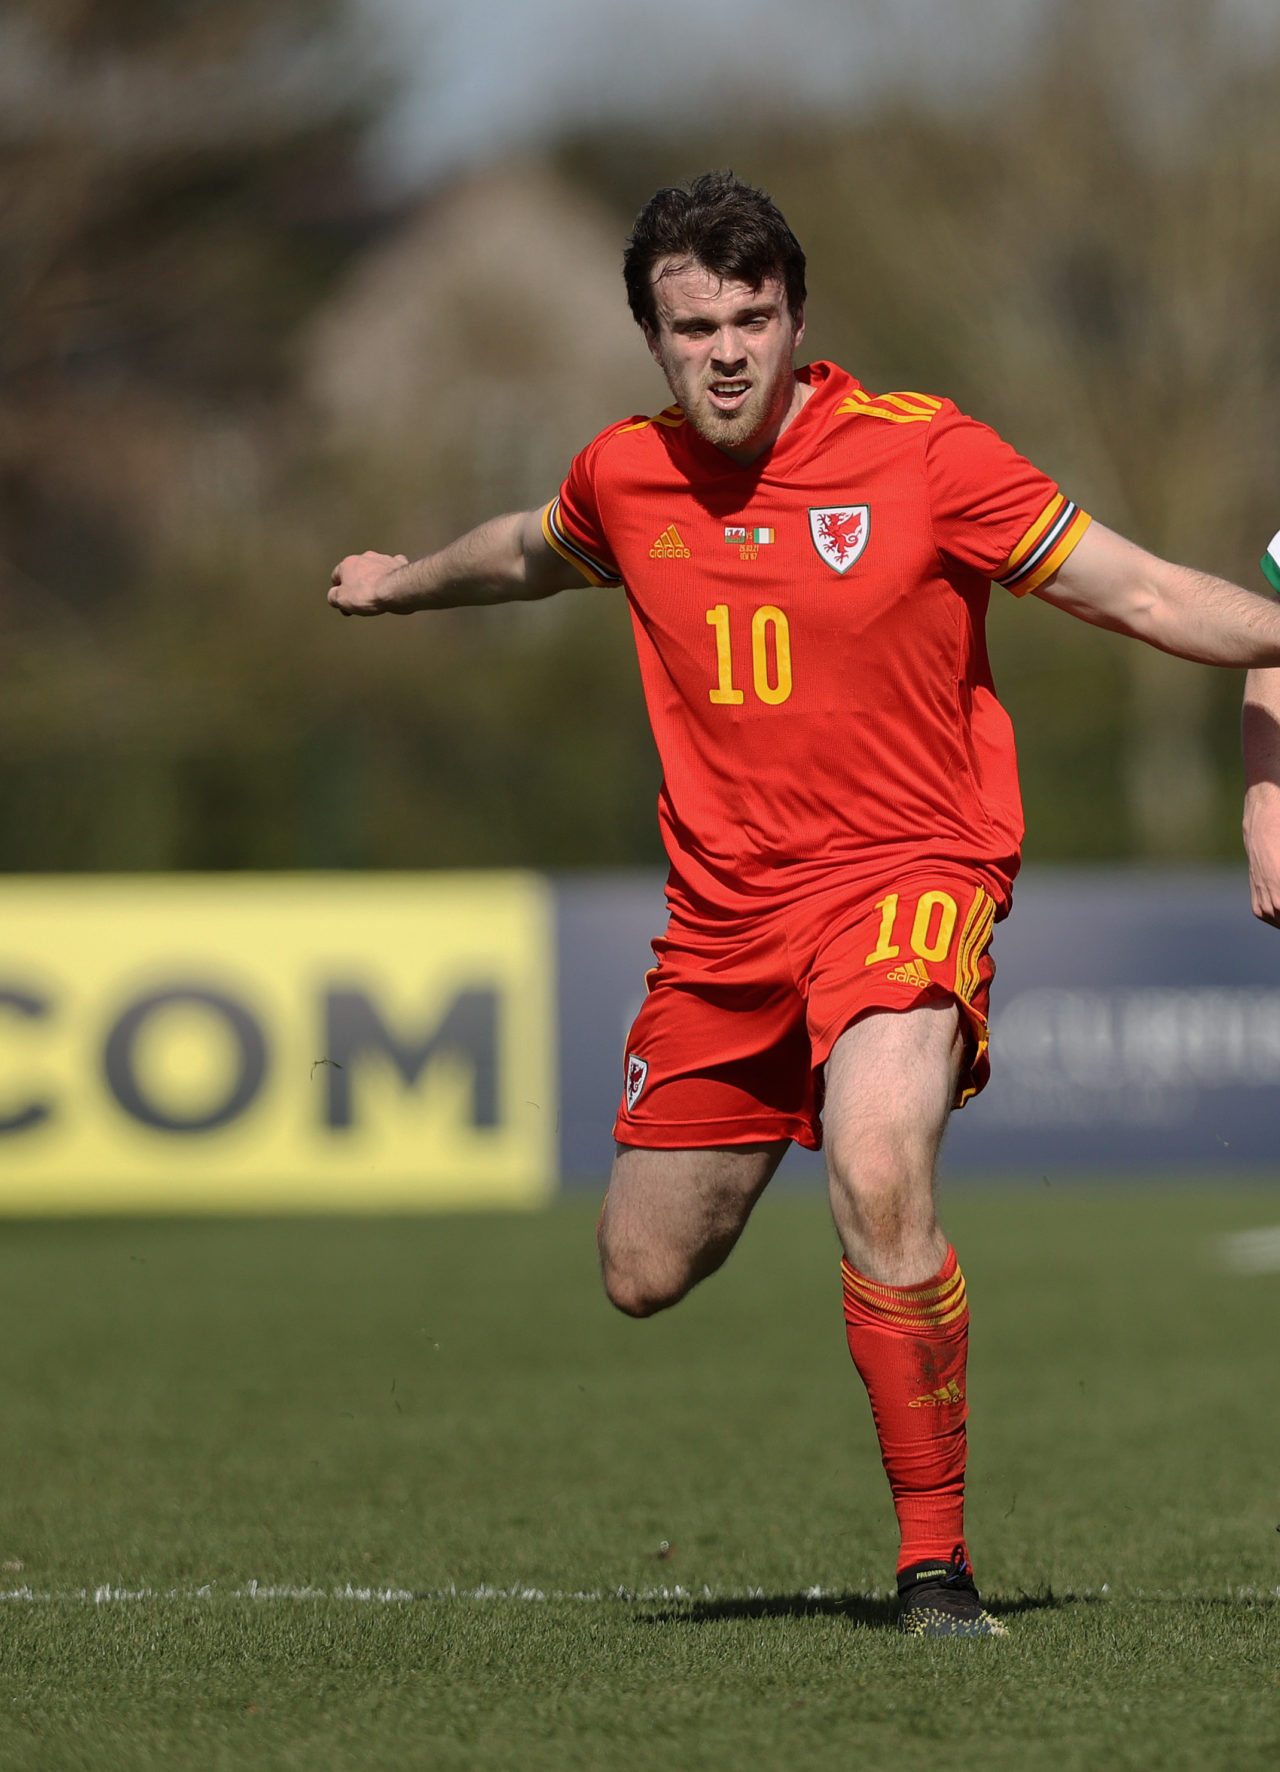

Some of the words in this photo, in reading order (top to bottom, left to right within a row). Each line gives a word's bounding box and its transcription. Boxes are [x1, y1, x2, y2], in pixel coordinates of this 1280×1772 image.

[649, 546, 691, 559] adidas
[706, 604, 793, 705] 10
[864, 890, 958, 966] 10
[887, 972, 930, 989] adida
